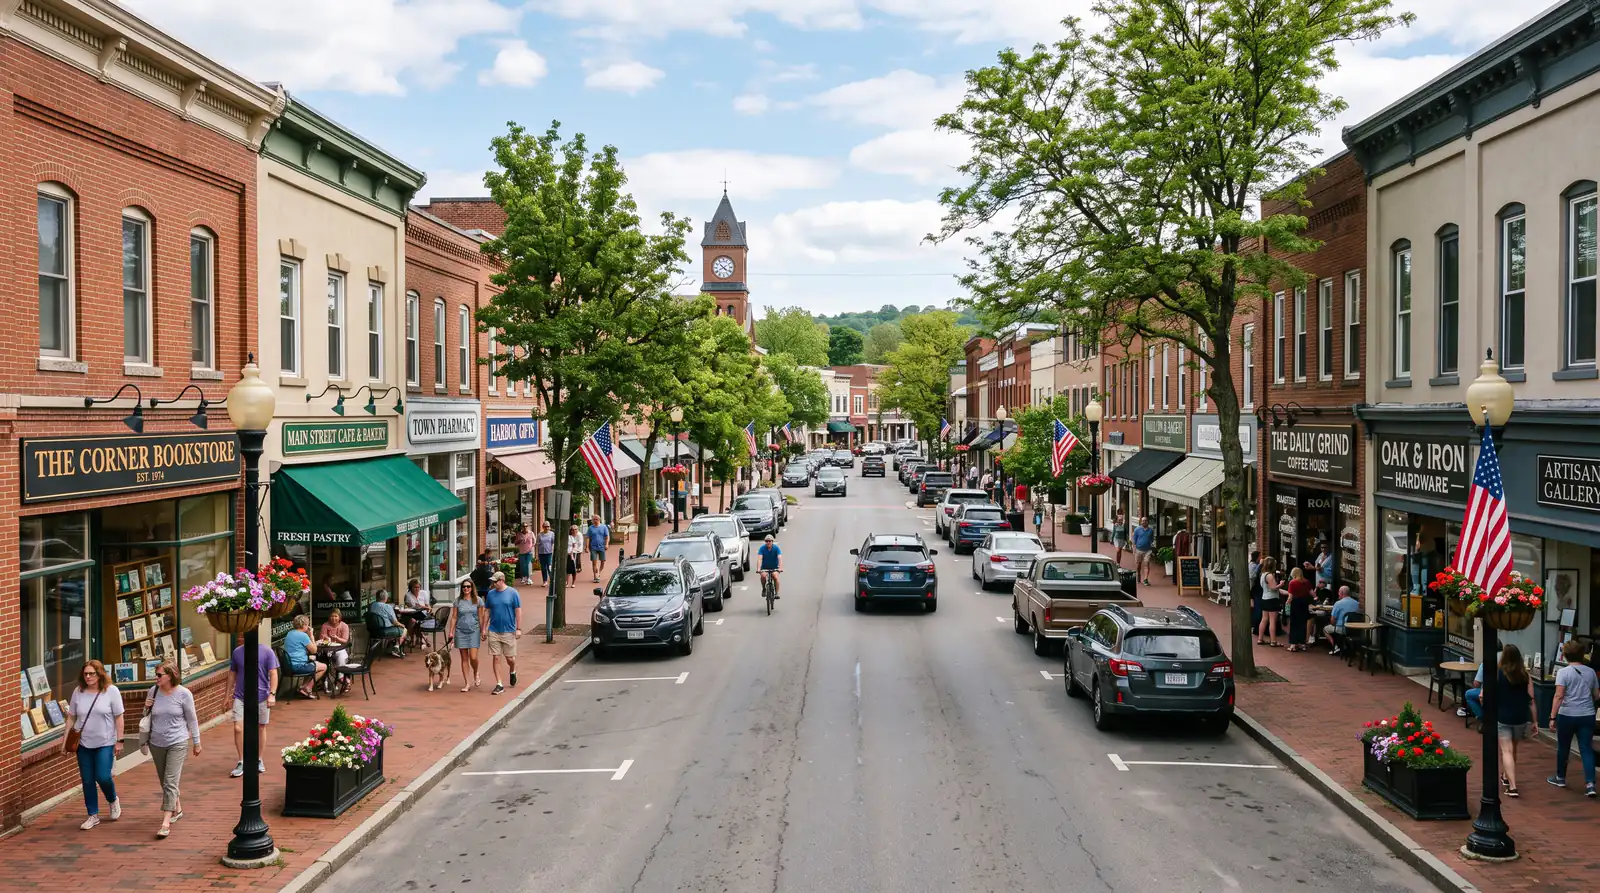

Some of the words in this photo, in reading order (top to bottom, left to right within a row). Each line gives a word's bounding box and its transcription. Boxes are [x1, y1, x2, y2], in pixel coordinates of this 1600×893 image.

[287, 430, 308, 446] MAIN
[309, 429, 337, 445] STREET
[338, 428, 356, 443] CAFE
[356, 427, 362, 442] &
[362, 427, 386, 442] BAKERY
[413, 418, 436, 436] TOWN
[437, 417, 475, 434] PHARMACY
[490, 423, 517, 442] HARBOR
[519, 422, 535, 439] GIFTS
[1271, 431, 1288, 451] THE
[1289, 431, 1315, 453] DAILY
[1317, 432, 1349, 456] GRIND
[34, 449, 76, 478] THE
[79, 445, 151, 475] CORNER
[152, 440, 236, 469] BOOKSTORE
[1287, 456, 1309, 470] COFFEE
[1309, 458, 1329, 473] HOUSE
[1381, 440, 1410, 468] OAK
[1413, 442, 1423, 469] &
[1427, 443, 1465, 473] IRON
[136, 472, 150, 483] EST.
[151, 471, 165, 481] 1974
[1395, 471, 1449, 494] HARDWARE
[1544, 461, 1600, 483] ARTISAN
[1544, 481, 1600, 504] GALLERY
[277, 531, 311, 541] FRESH
[313, 533, 352, 543] PASTRY
